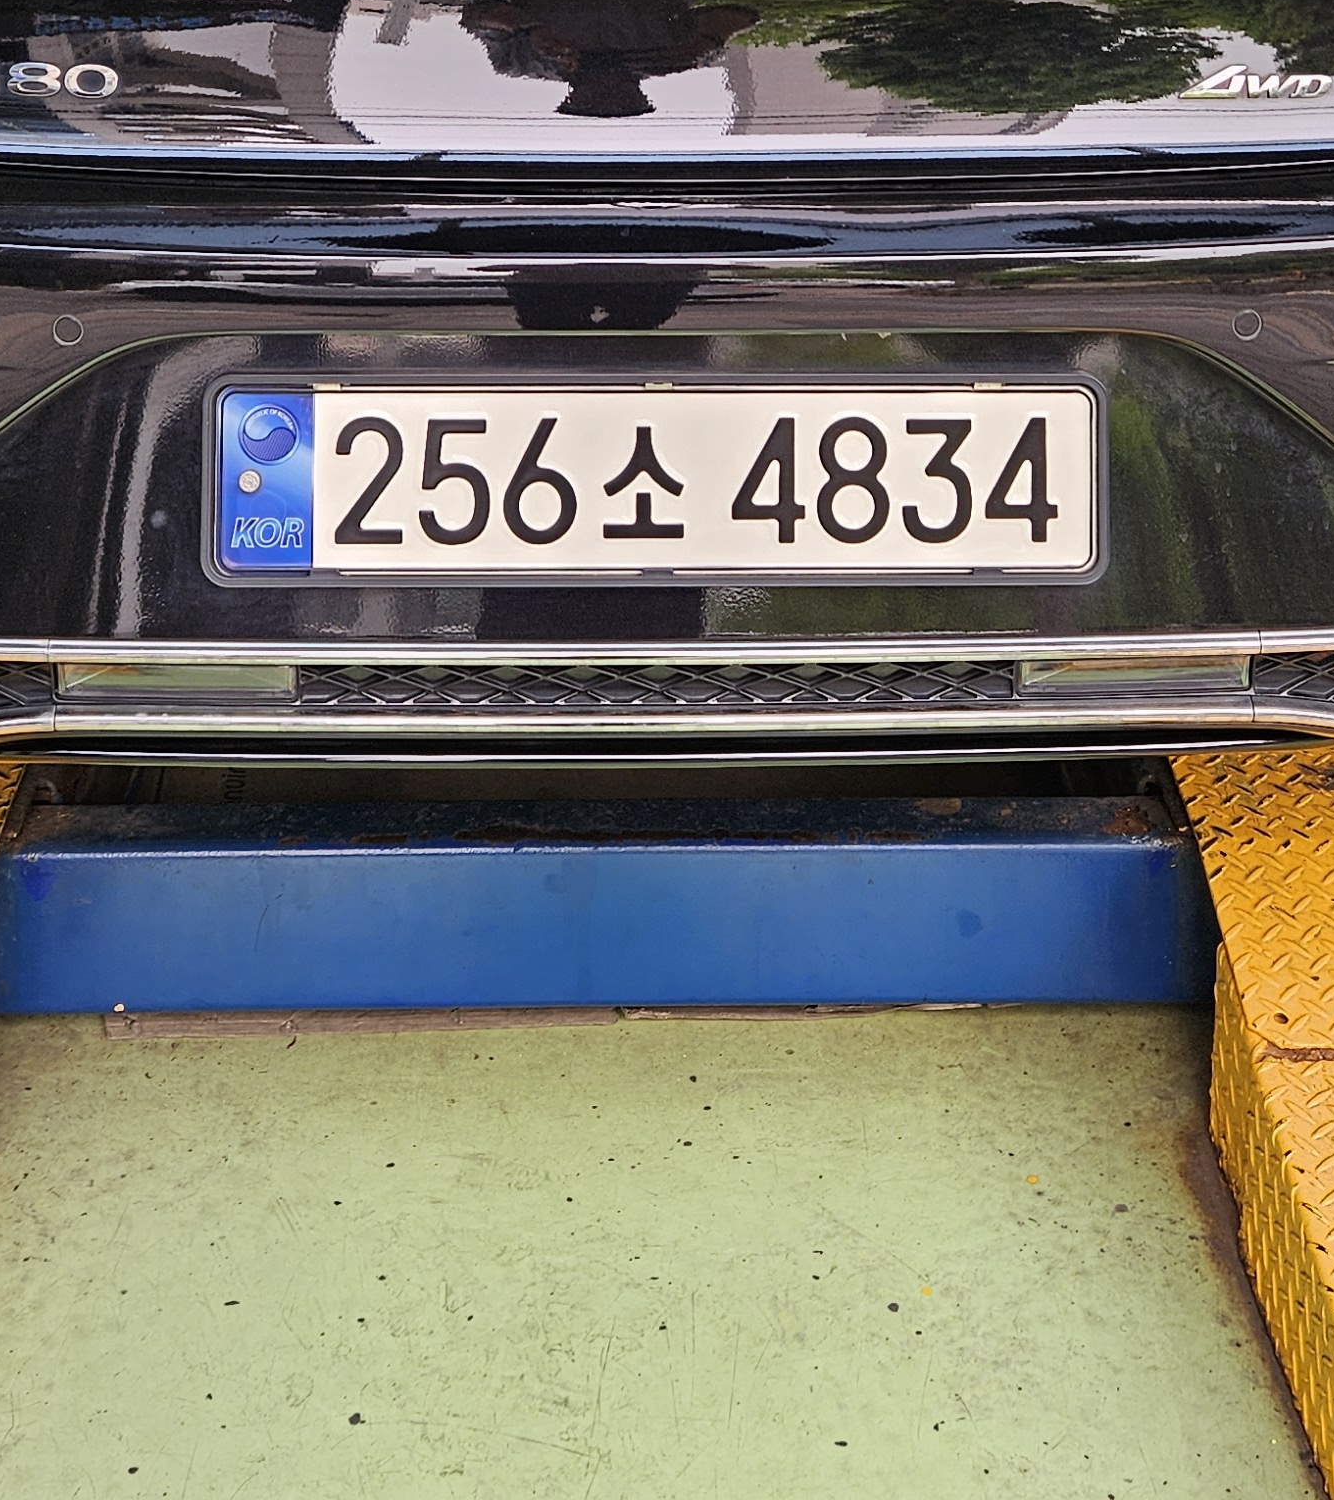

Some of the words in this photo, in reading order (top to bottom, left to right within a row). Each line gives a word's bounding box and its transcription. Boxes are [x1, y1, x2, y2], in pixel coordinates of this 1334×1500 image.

[334, 416, 685, 546] 256소
[730, 416, 1060, 546] 4834
[230, 516, 305, 549] KOR
